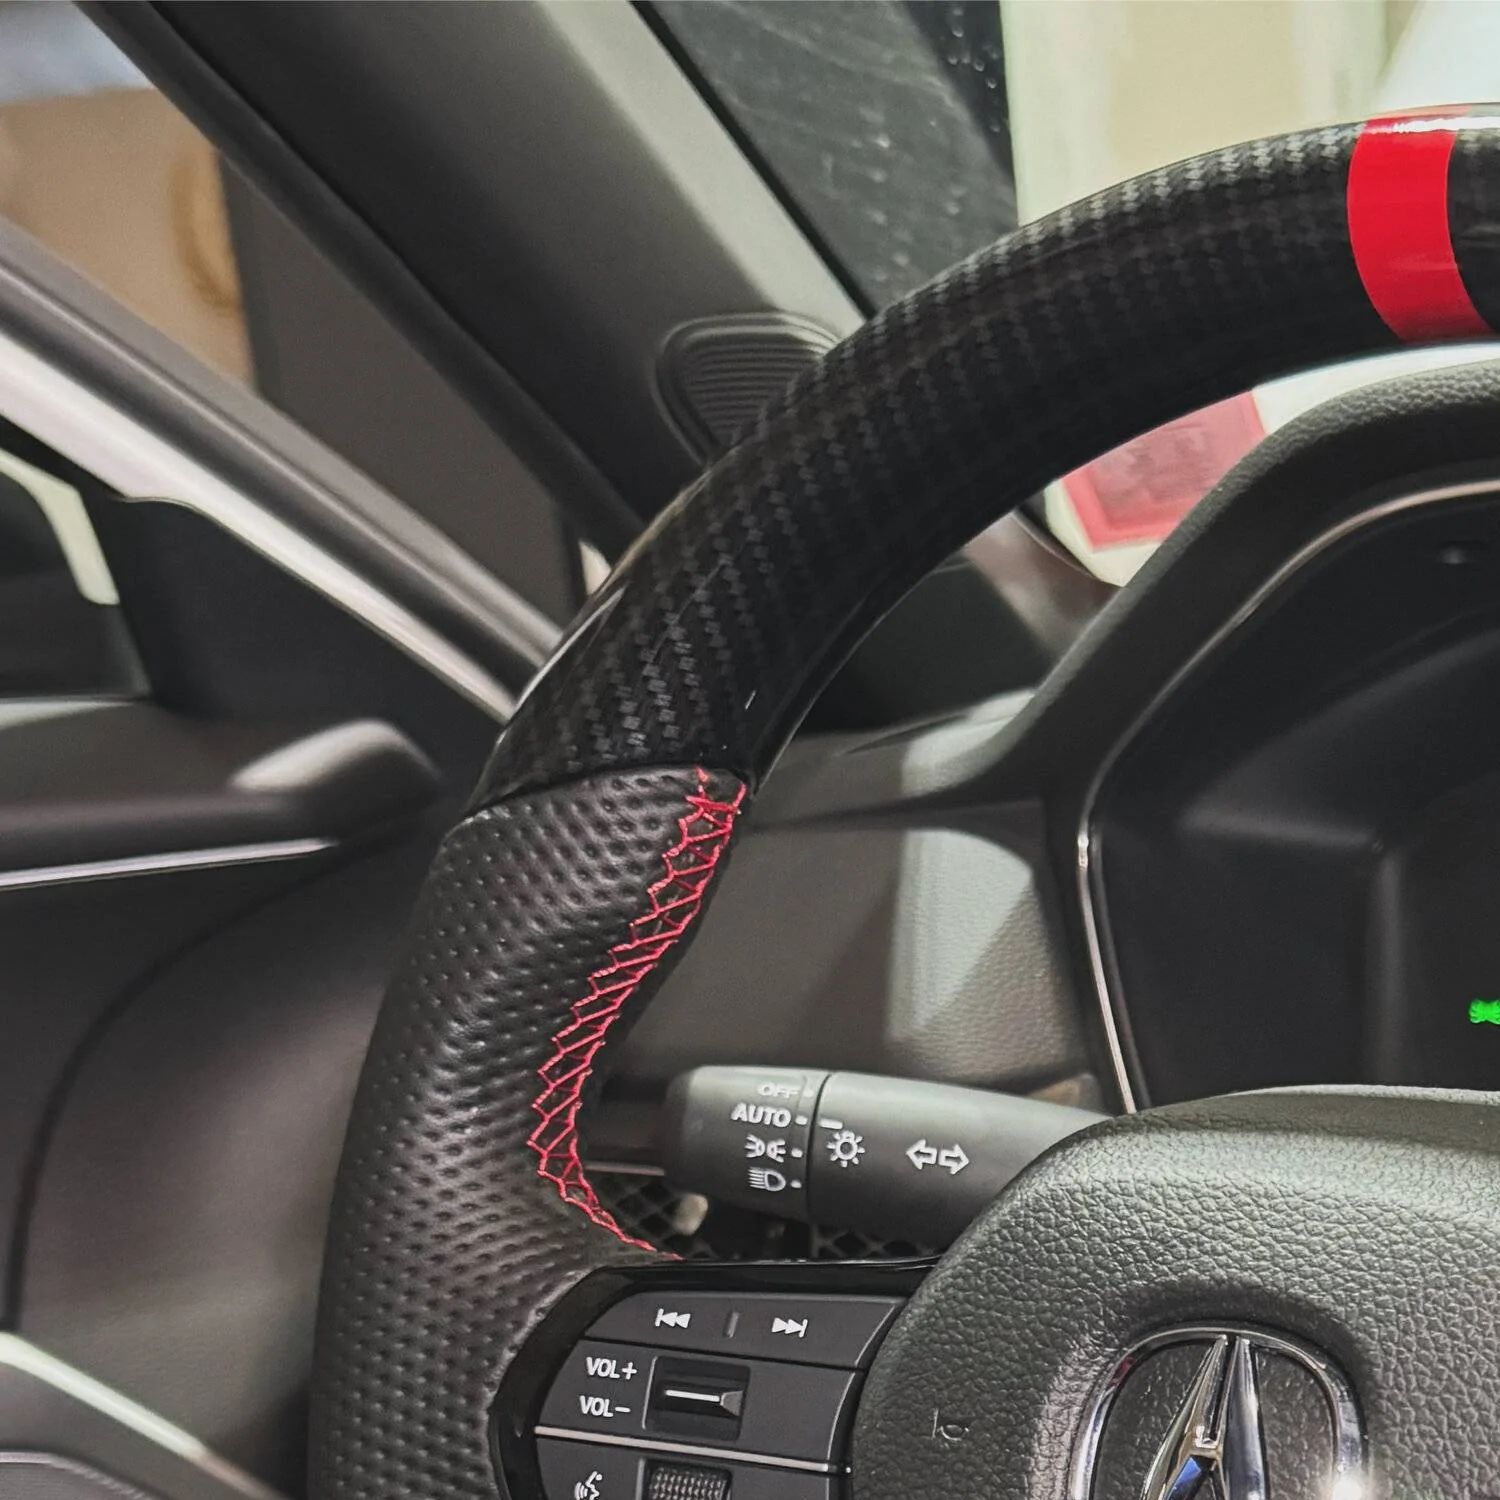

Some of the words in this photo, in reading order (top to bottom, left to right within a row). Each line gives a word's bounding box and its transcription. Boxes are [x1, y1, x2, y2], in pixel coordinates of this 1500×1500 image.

[757, 1082, 800, 1099] OFF
[730, 1102, 793, 1128] AUTO
[586, 1356, 638, 1380] VOL+
[579, 1396, 631, 1417] VOL-
